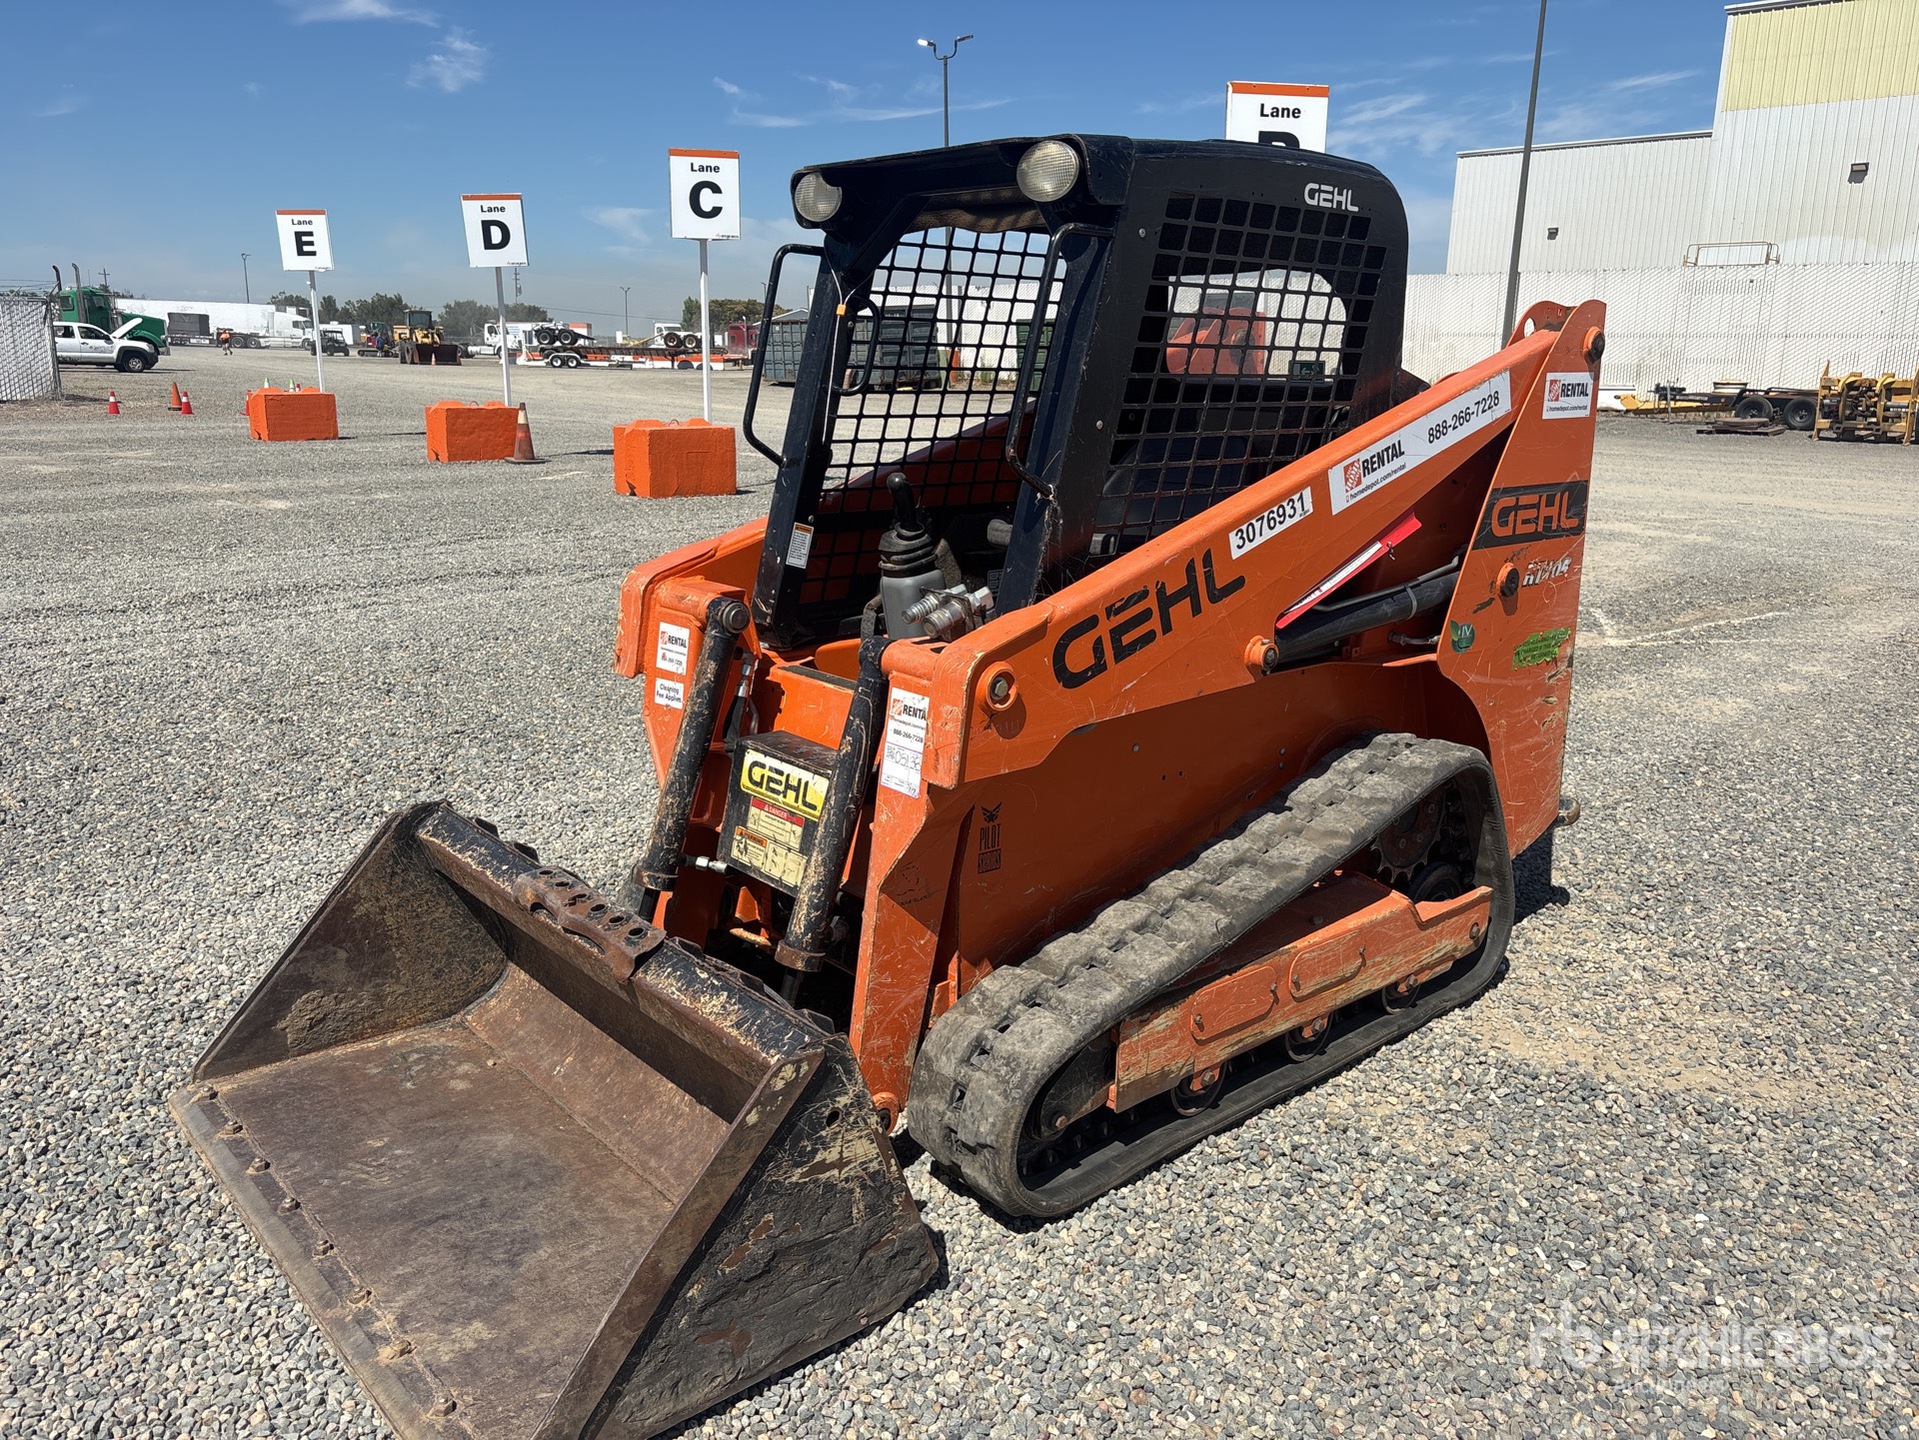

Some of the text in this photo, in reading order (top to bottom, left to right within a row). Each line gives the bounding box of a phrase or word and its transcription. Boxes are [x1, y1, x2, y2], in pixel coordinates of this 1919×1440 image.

[1260, 103, 1302, 119] Lane
[690, 162, 721, 173] Lane
[480, 204, 506, 213] Lane
[689, 180, 723, 219] C
[1304, 182, 1359, 212] GEHL
[291, 218, 313, 226] Lane
[480, 219, 511, 250] D
[294, 231, 317, 256] E
[1560, 382, 1589, 398] RENTAL
[1427, 390, 1500, 444] 888-266-7228
[1361, 439, 1405, 478] RENTAL
[1349, 461, 1406, 500] homedepot.com/rental
[1235, 491, 1305, 549] 3076931
[1491, 491, 1579, 537] GEHL
[1052, 548, 1246, 689] GEHL
[668, 635, 687, 649] RENTAL
[902, 704, 927, 721] RENTA
[748, 760, 818, 812] GEHL
[768, 804, 788, 820] DANGER
[980, 823, 1002, 851] PILOT
